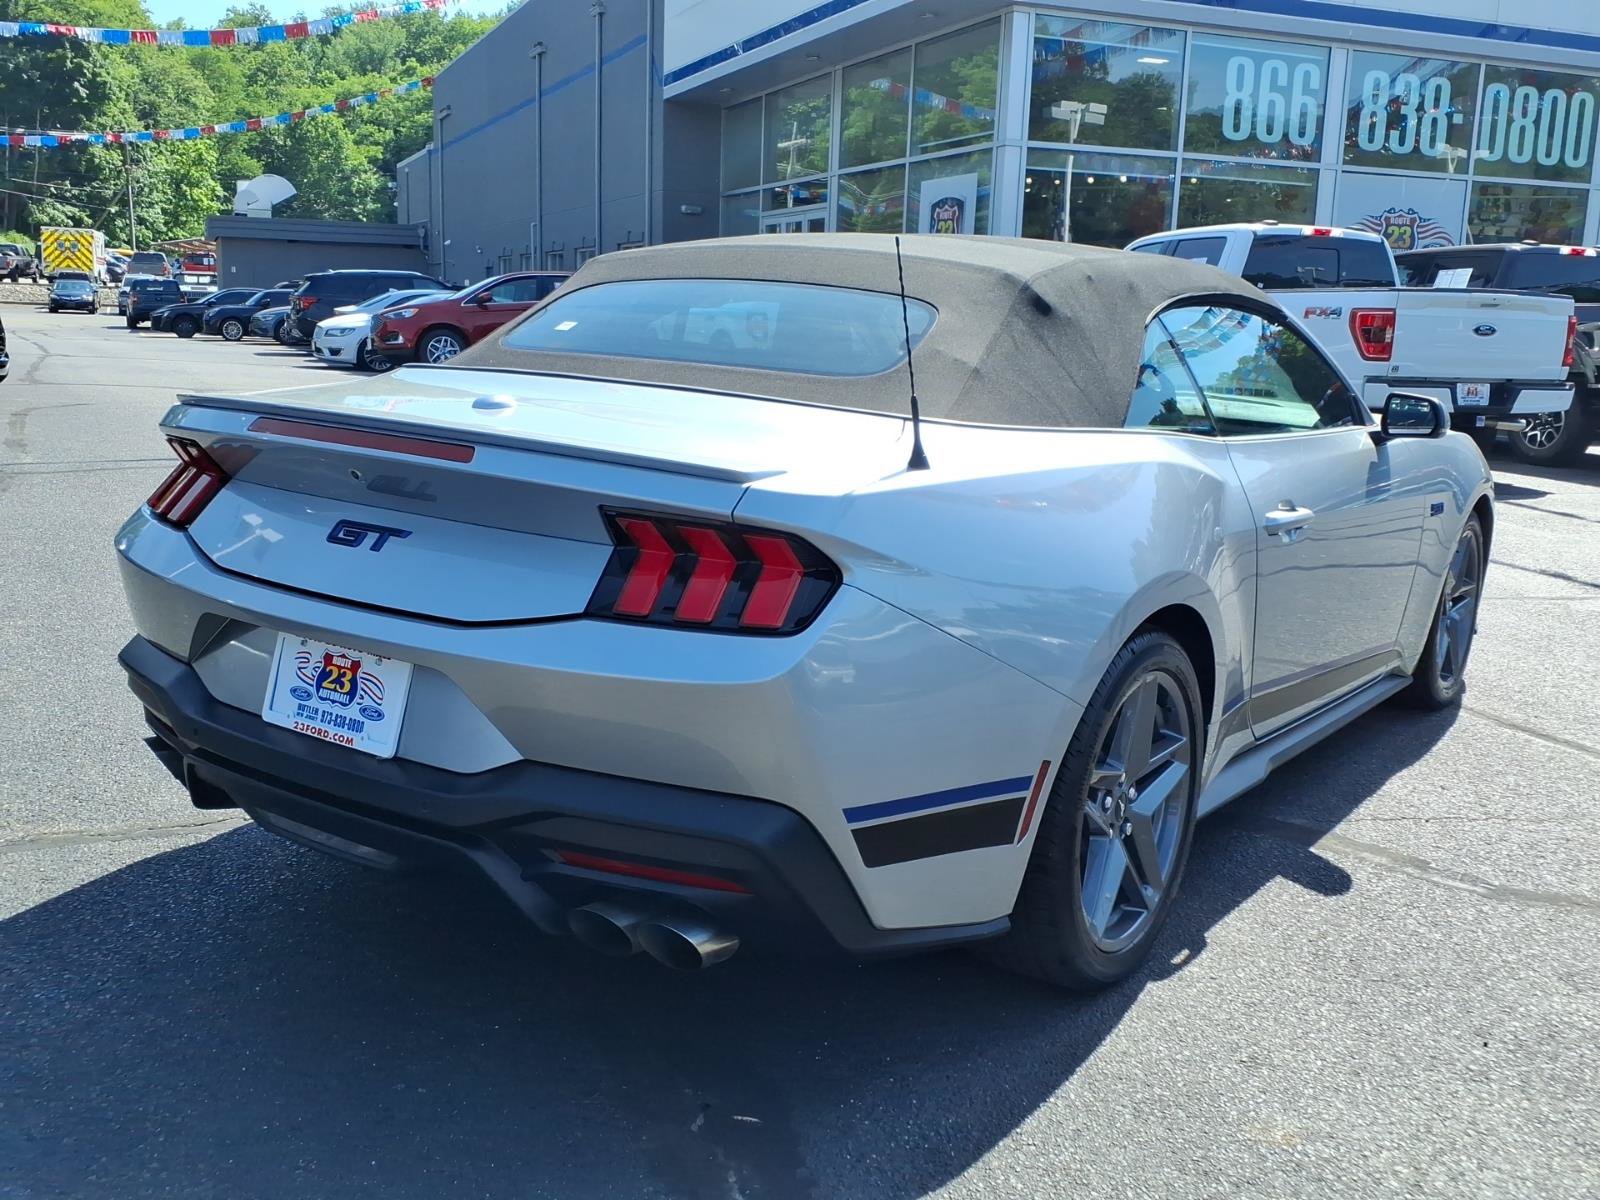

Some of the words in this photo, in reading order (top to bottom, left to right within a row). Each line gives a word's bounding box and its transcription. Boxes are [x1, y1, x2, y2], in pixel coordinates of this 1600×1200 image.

[1222, 56, 1320, 146] 866
[1481, 83, 1594, 168] 0800
[1387, 226, 1412, 248] 23
[1303, 306, 1343, 319] FX4
[326, 518, 413, 552] GT
[332, 656, 351, 668] ROUTE
[322, 666, 352, 692] 23
[318, 688, 350, 704] AUTOMALL
[297, 703, 319, 715] BUTLER
[293, 721, 354, 746] 23FORD.COM
